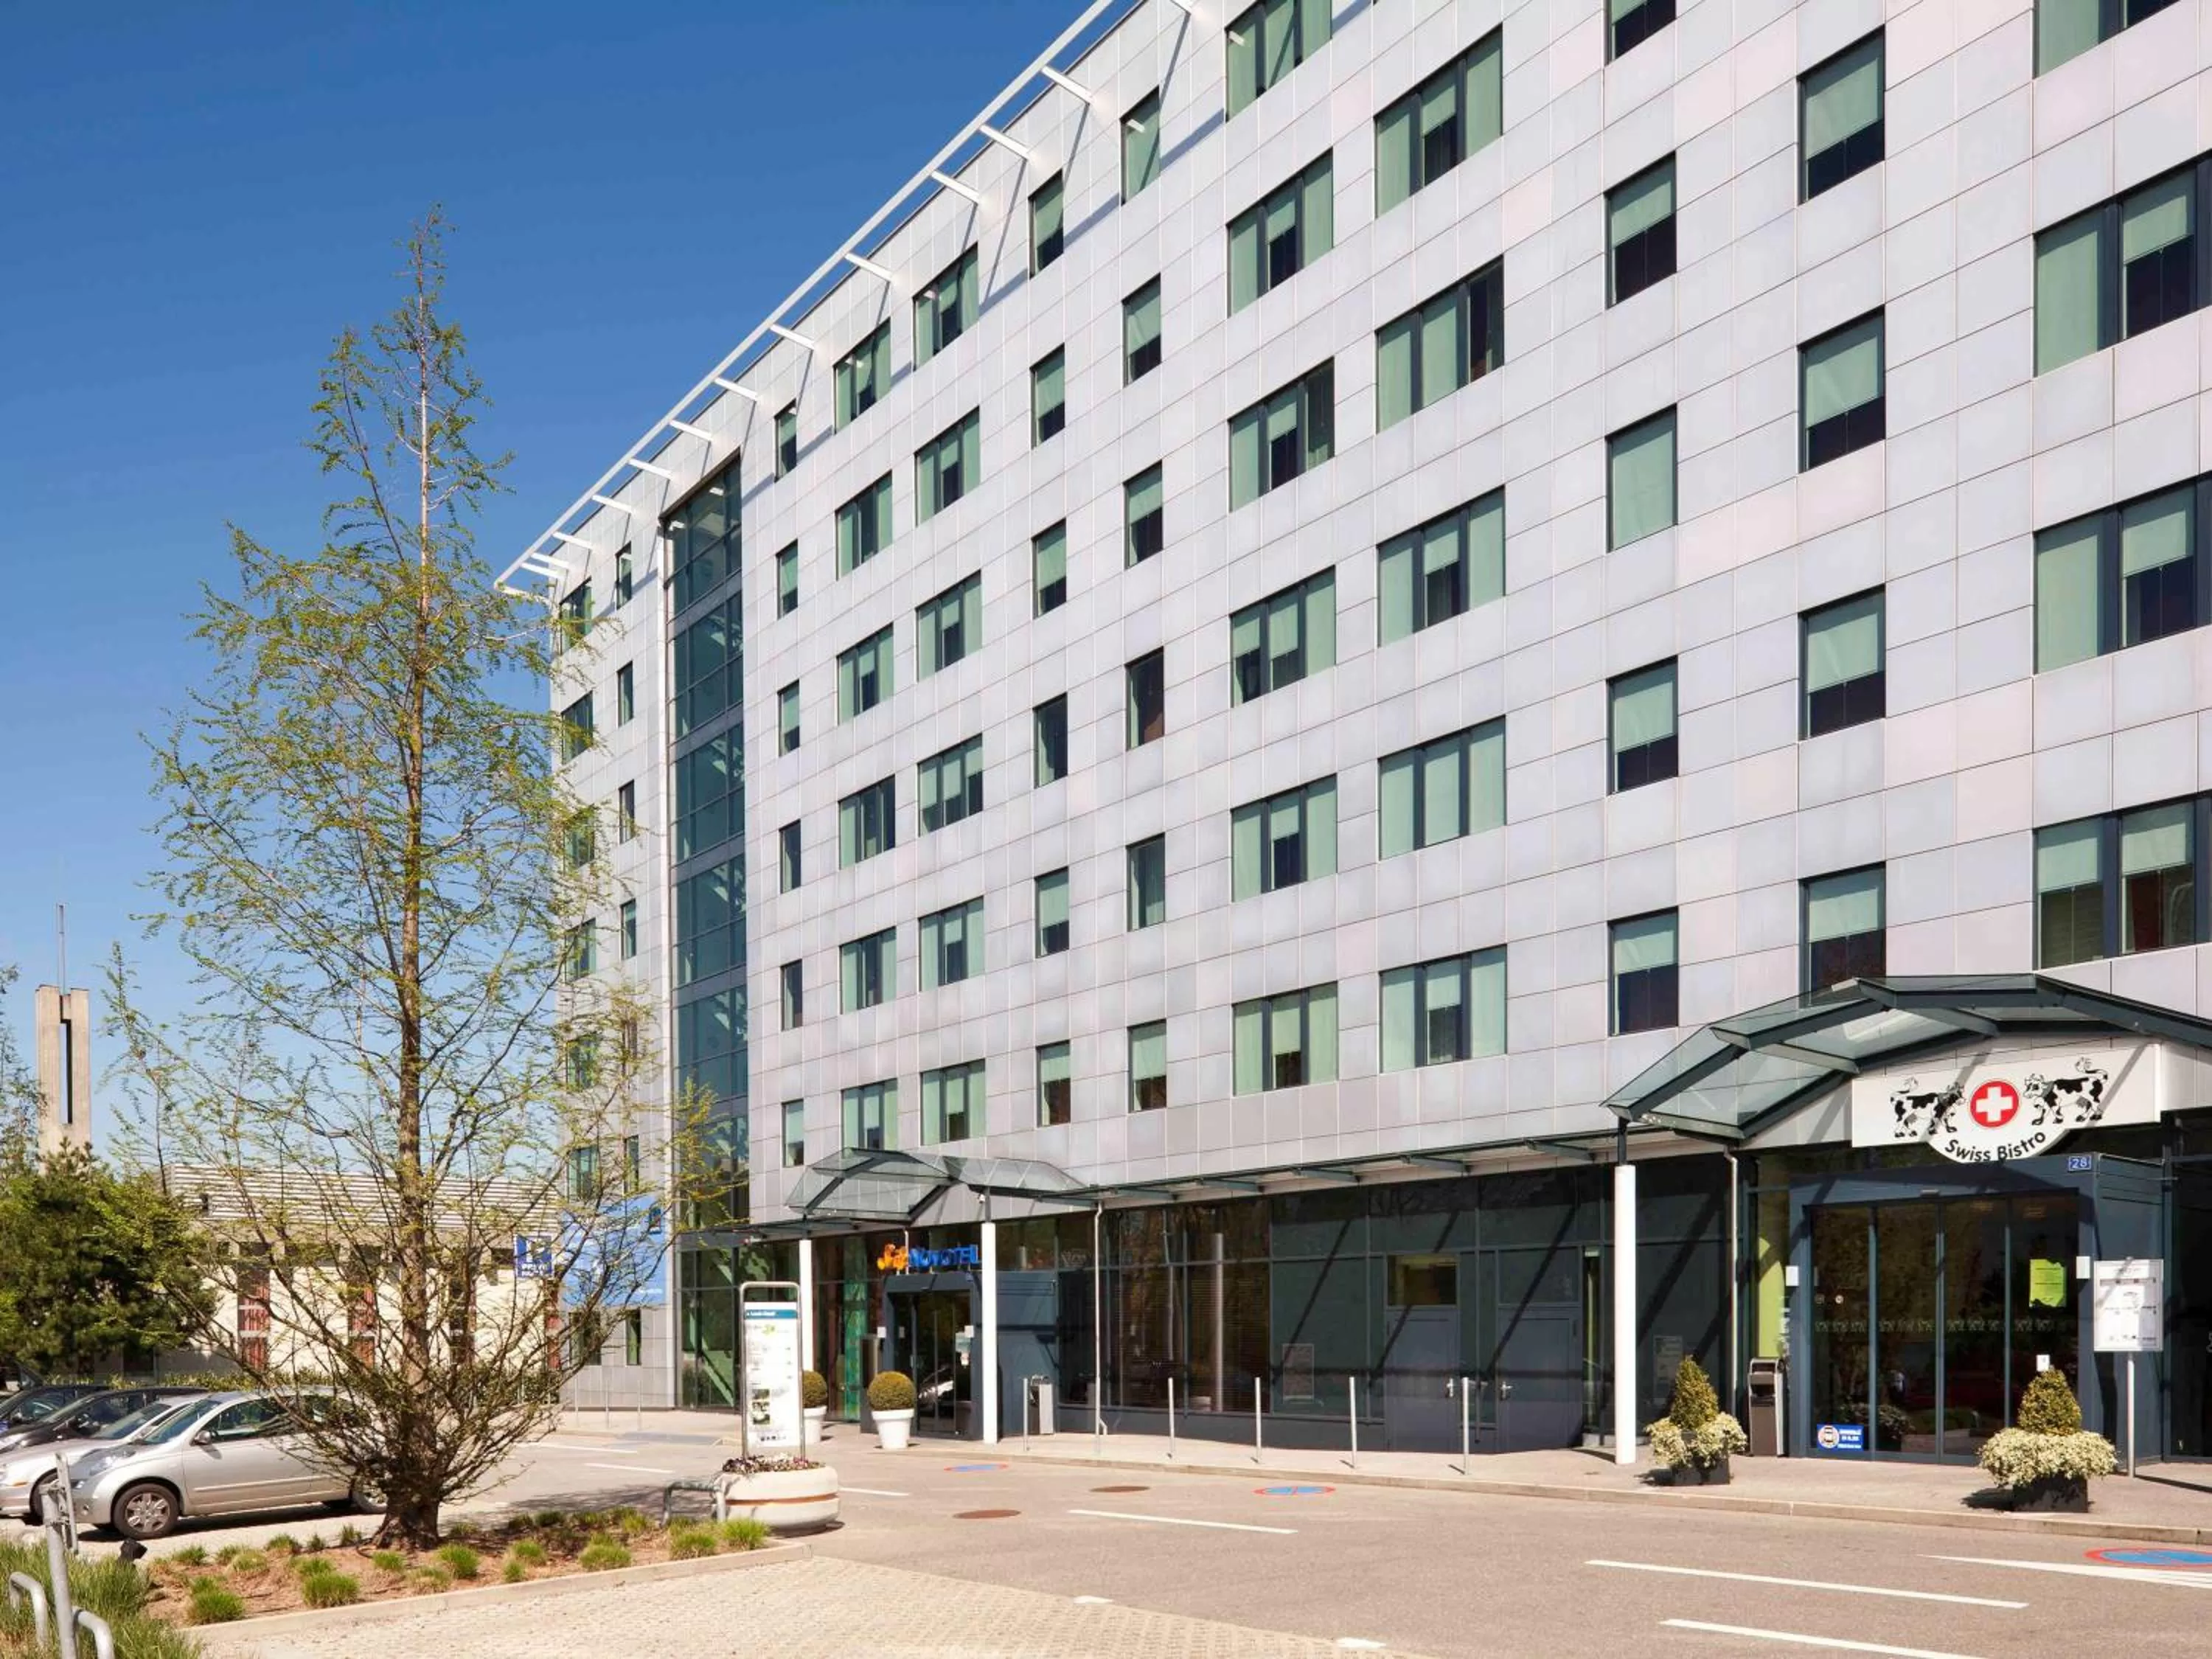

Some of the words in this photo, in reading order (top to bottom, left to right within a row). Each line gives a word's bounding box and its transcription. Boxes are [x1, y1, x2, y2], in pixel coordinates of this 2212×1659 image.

[1944, 1139, 1991, 1162] Swiss
[1997, 1132, 2045, 1158] Bistro
[2071, 1159, 2087, 1169] 28
